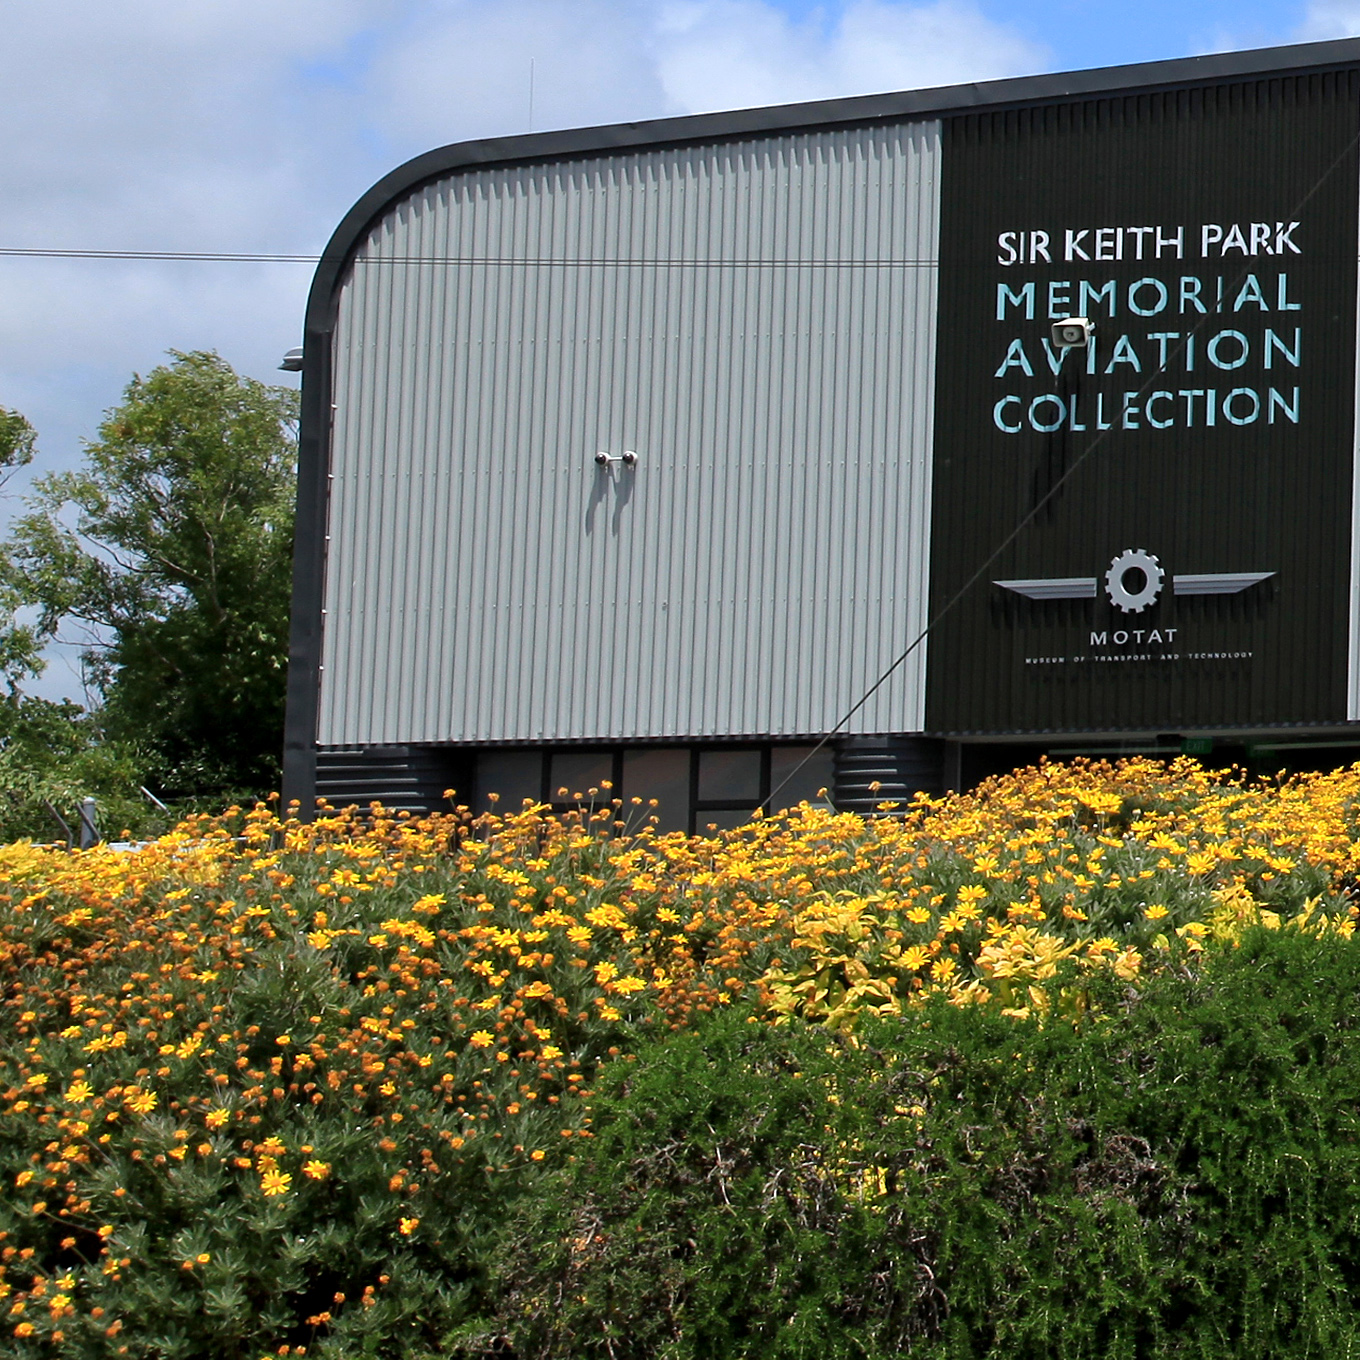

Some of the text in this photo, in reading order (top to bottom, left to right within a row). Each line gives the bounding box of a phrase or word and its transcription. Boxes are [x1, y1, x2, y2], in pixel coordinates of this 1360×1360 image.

[997, 221, 1302, 266] SIR KEITH PARK
[996, 273, 1302, 321] MEMORIAL
[994, 327, 1301, 378] AVIATION
[993, 386, 1300, 434] COLLECTION
[1025, 657, 1066, 665] MUSEUM
[1094, 654, 1152, 662] TRANSPORT
[1160, 653, 1180, 661] AND
[1188, 651, 1253, 660] TECHNOLOGY
[1089, 628, 1178, 646] MOTAT
